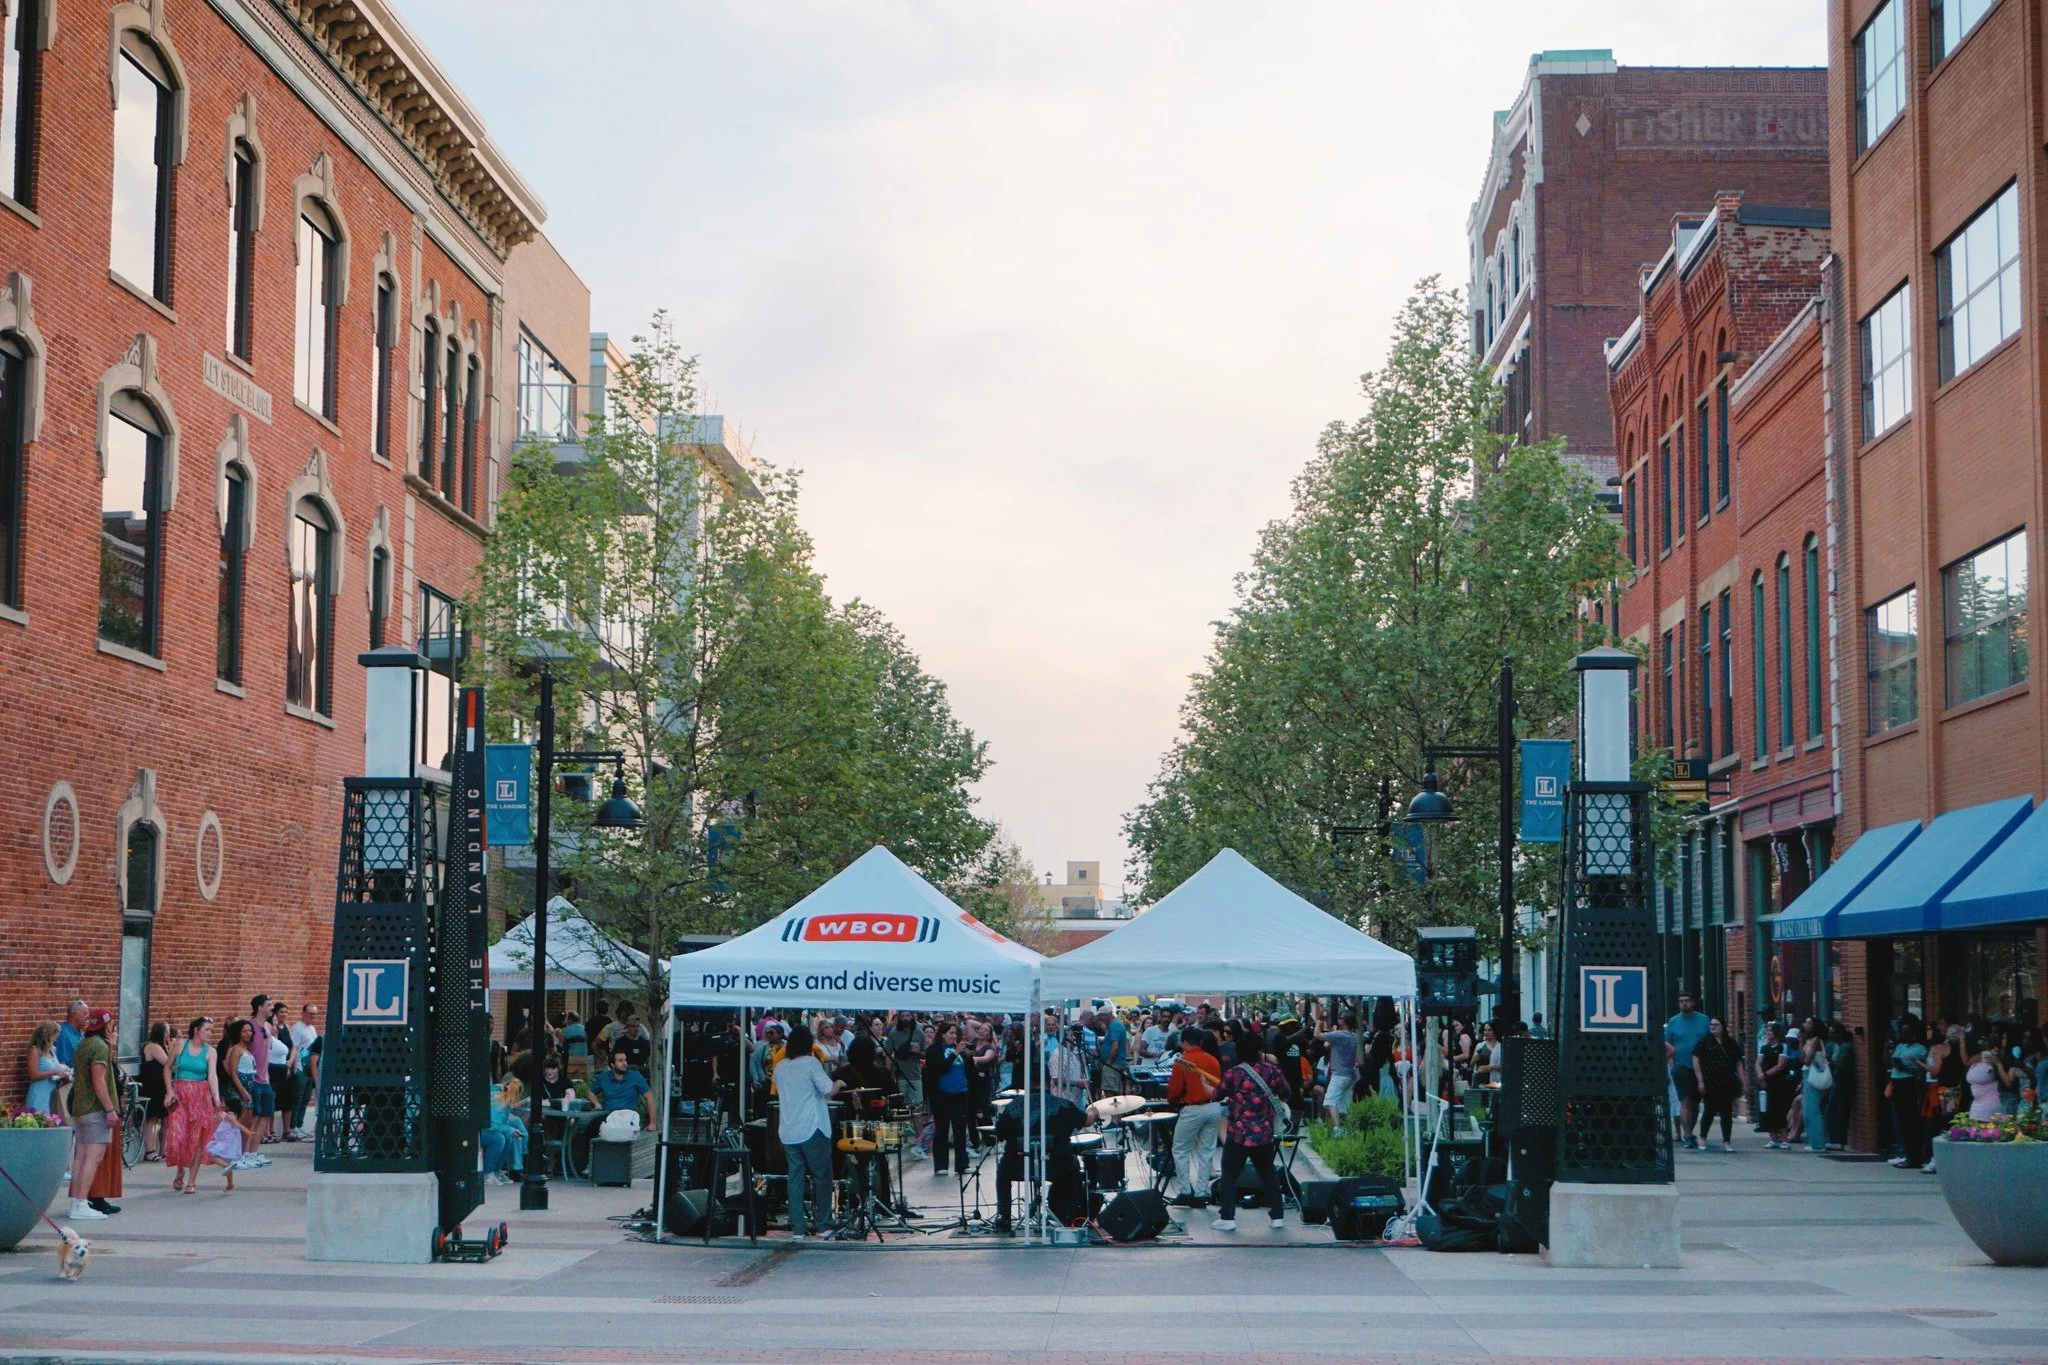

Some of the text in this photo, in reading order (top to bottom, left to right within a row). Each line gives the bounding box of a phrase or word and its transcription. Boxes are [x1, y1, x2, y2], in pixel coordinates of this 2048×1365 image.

[468, 788, 483, 1010] THE LANDING
[818, 921, 905, 936] WBOI
[702, 970, 1001, 994] npr news and diverse music
